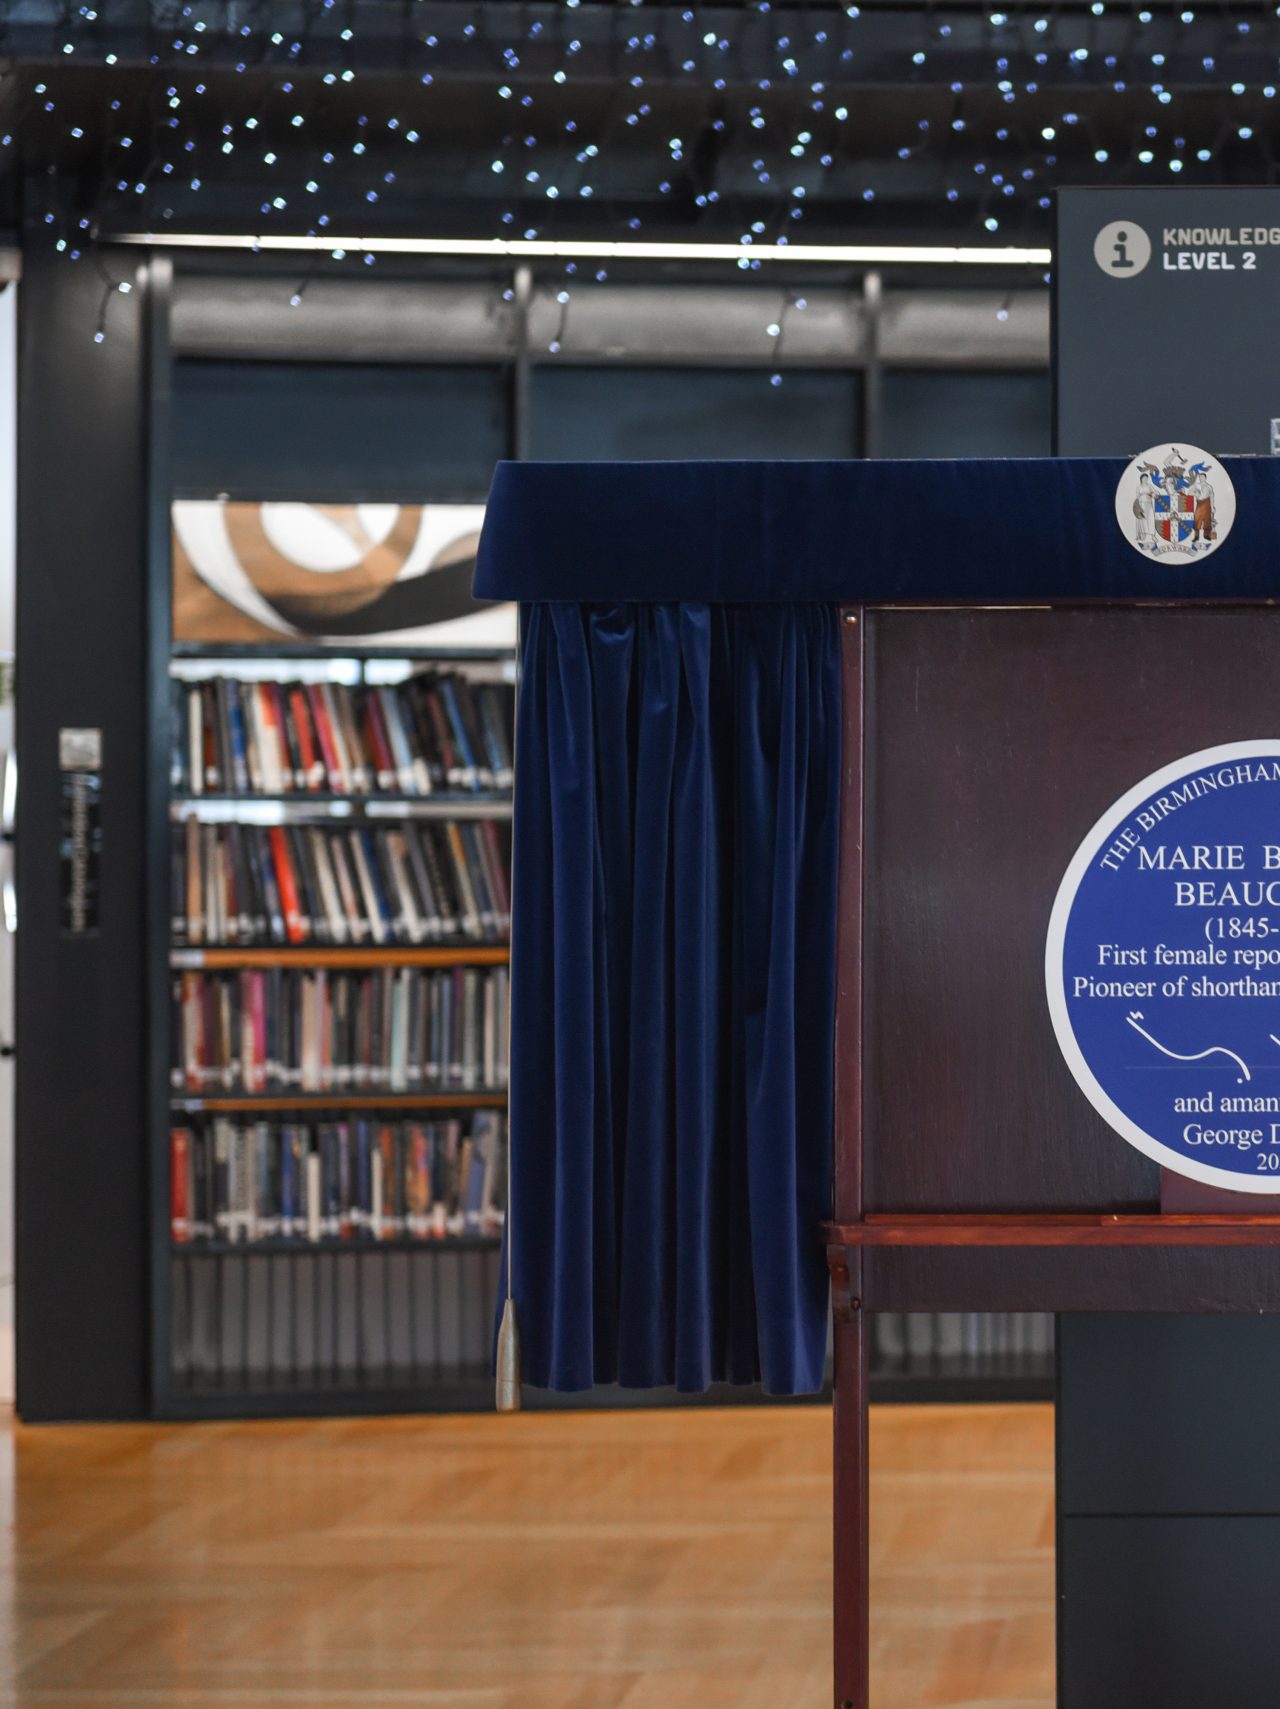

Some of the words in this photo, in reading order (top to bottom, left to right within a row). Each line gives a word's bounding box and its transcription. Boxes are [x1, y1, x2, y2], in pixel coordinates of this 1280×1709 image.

[1163, 251, 1236, 271] LEVEL
[1242, 251, 1257, 271] 2
[1100, 829, 1140, 872] THE
[1138, 845, 1245, 870] MARIE
[1098, 943, 1148, 966] First
[1153, 943, 1228, 966] female
[1073, 975, 1157, 998] Pioneer
[1162, 975, 1189, 997] of
[1174, 1091, 1214, 1113] and
[1183, 1123, 1264, 1151] George
